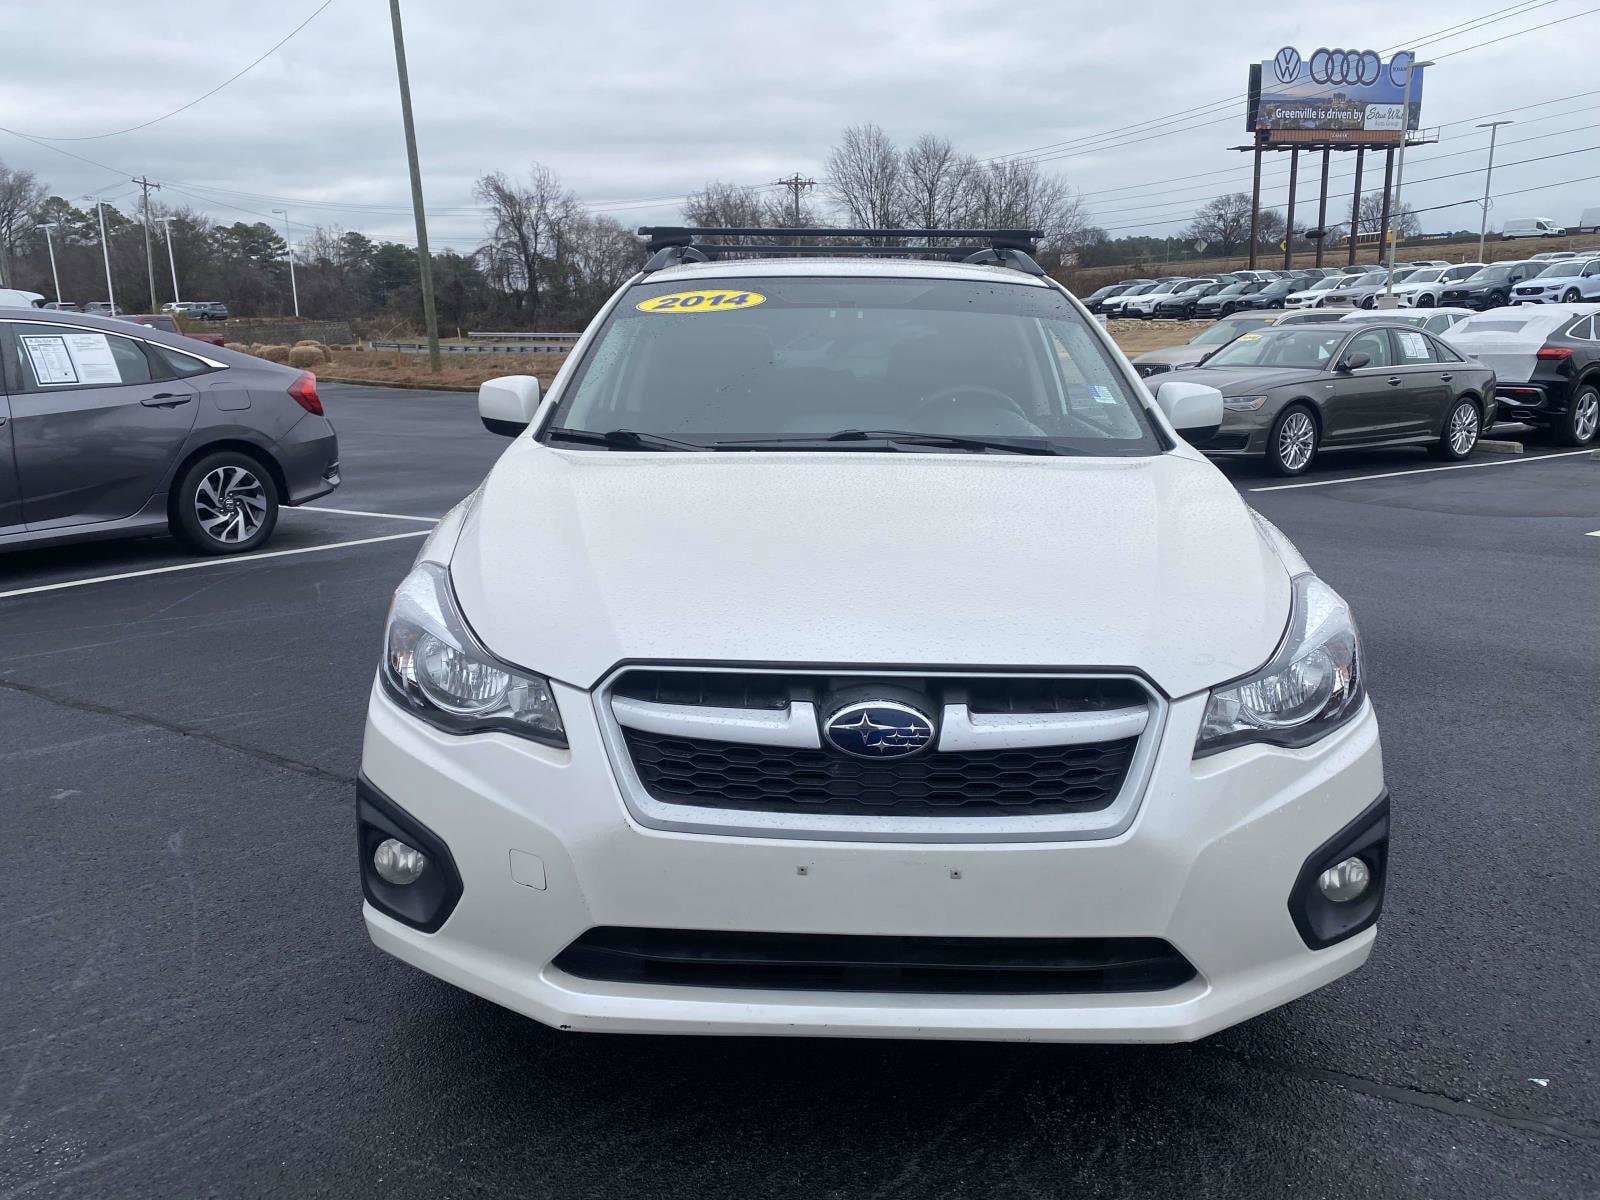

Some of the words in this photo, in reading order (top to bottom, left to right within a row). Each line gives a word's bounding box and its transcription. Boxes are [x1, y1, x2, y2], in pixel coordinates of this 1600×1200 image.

[1275, 107, 1317, 119] Greenville
[1318, 108, 1326, 119] is
[1327, 108, 1352, 119] driven
[1353, 108, 1364, 122] by
[651, 293, 750, 310] 2014
